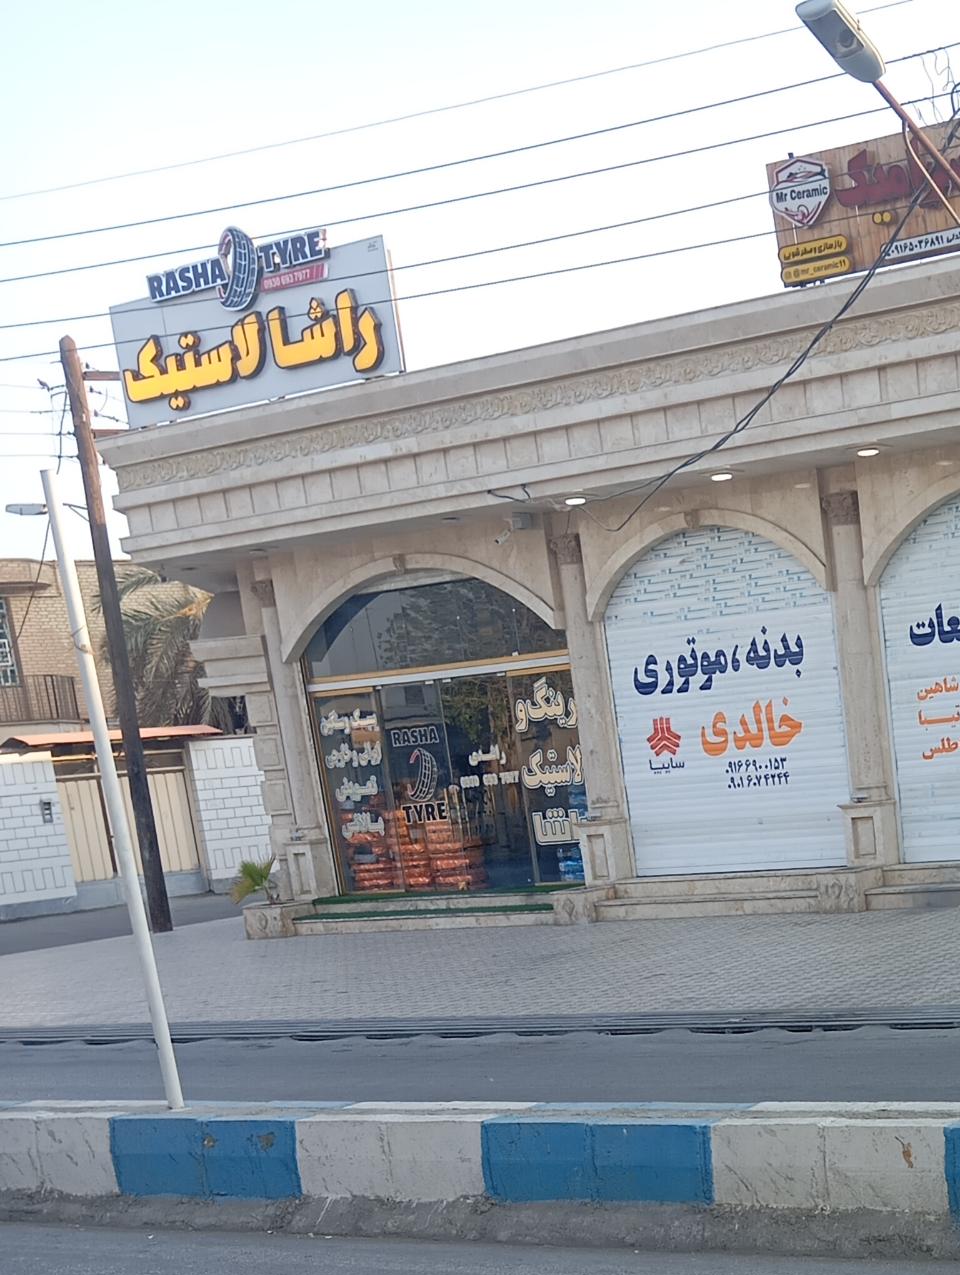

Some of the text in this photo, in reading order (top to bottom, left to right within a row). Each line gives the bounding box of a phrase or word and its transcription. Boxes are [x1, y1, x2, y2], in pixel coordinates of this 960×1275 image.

[776, 185, 828, 203] Mr Ceramic
[150, 230, 323, 301] RASHA TYRE
[123, 288, 380, 411] راشا لاستیک
[917, 676, 960, 701] شاهین
[527, 677, 578, 727] رینگ
[701, 696, 804, 757] خالدی
[918, 704, 960, 732] تیبا
[390, 726, 439, 747] RASHA
[522, 744, 585, 796] لاستیک
[649, 757, 685, 775] سایپا
[725, 757, 788, 774] ۰۹۱۶۶۹۰۰۱۵۳
[727, 771, 790, 789] ۰۹۰۱۶۰۷۴۲۴۴
[402, 801, 449, 825] TYRE
